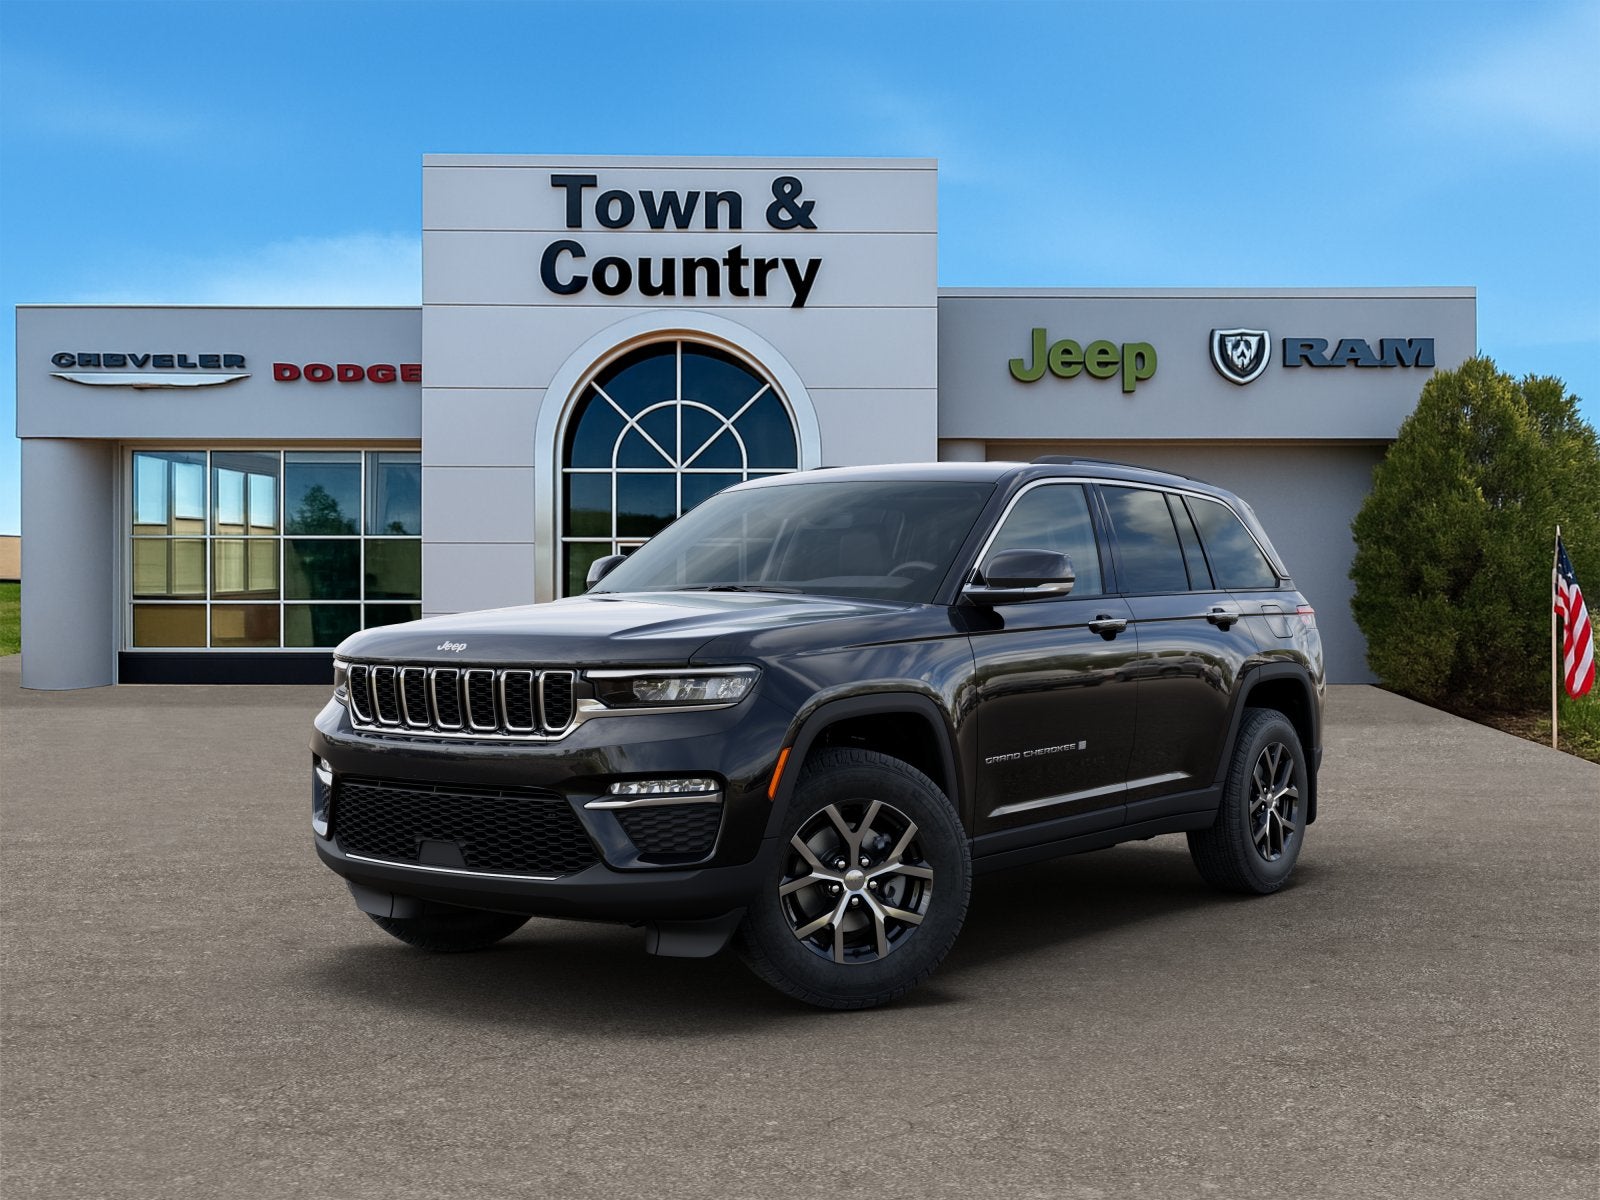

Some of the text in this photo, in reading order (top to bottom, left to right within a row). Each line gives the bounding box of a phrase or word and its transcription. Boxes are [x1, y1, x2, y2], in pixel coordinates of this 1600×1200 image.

[551, 174, 818, 230] Town &
[540, 239, 822, 308] Country
[1009, 328, 1157, 392] Jeep
[1282, 337, 1435, 368] RAM
[273, 363, 422, 382] DODGE
[437, 640, 467, 652] Jeep
[985, 752, 1021, 764] GRAND
[1023, 743, 1076, 757] CHEROKEE
